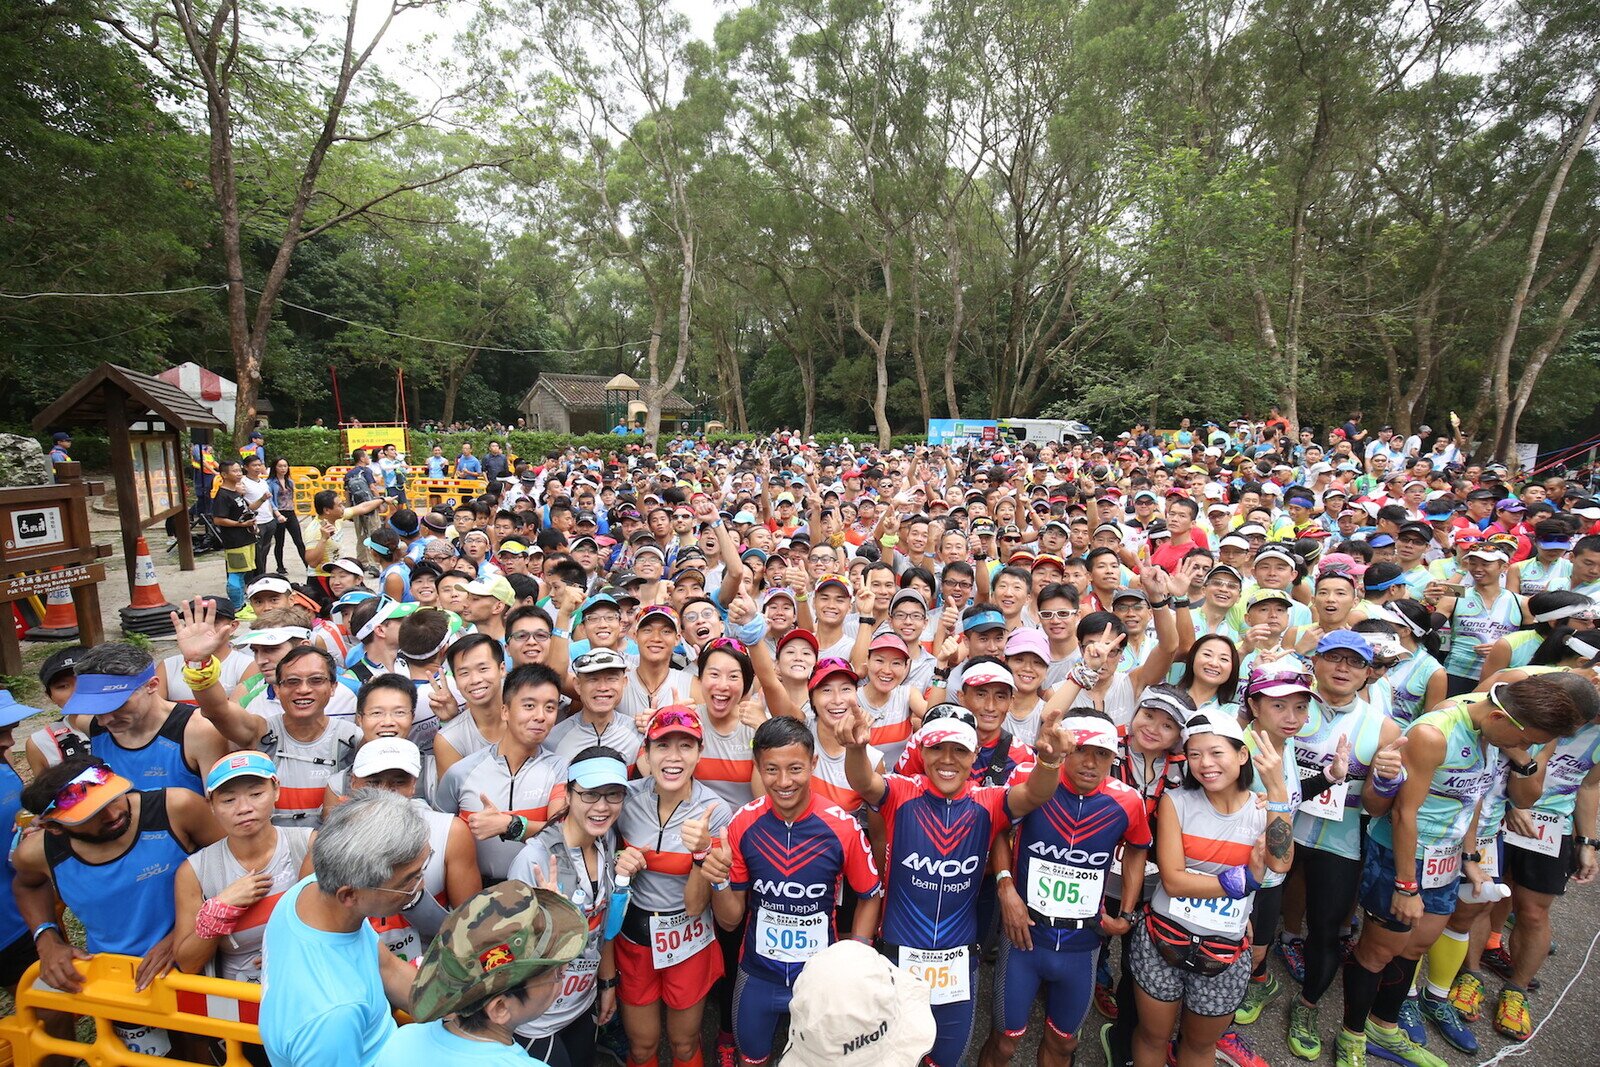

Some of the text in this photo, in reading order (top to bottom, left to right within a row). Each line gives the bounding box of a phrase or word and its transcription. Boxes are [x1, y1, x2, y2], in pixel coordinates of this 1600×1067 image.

[33, 582, 52, 590] Chung
[1536, 812, 1558, 824] 2016
[1075, 871, 1099, 881] 2016
[911, 874, 971, 894] team nepal
[760, 898, 819, 915] team nepal
[799, 916, 823, 927] 2016
[389, 934, 414, 952] 2016
[943, 948, 964, 962] 2016
[842, 1020, 888, 1056] Nikon
